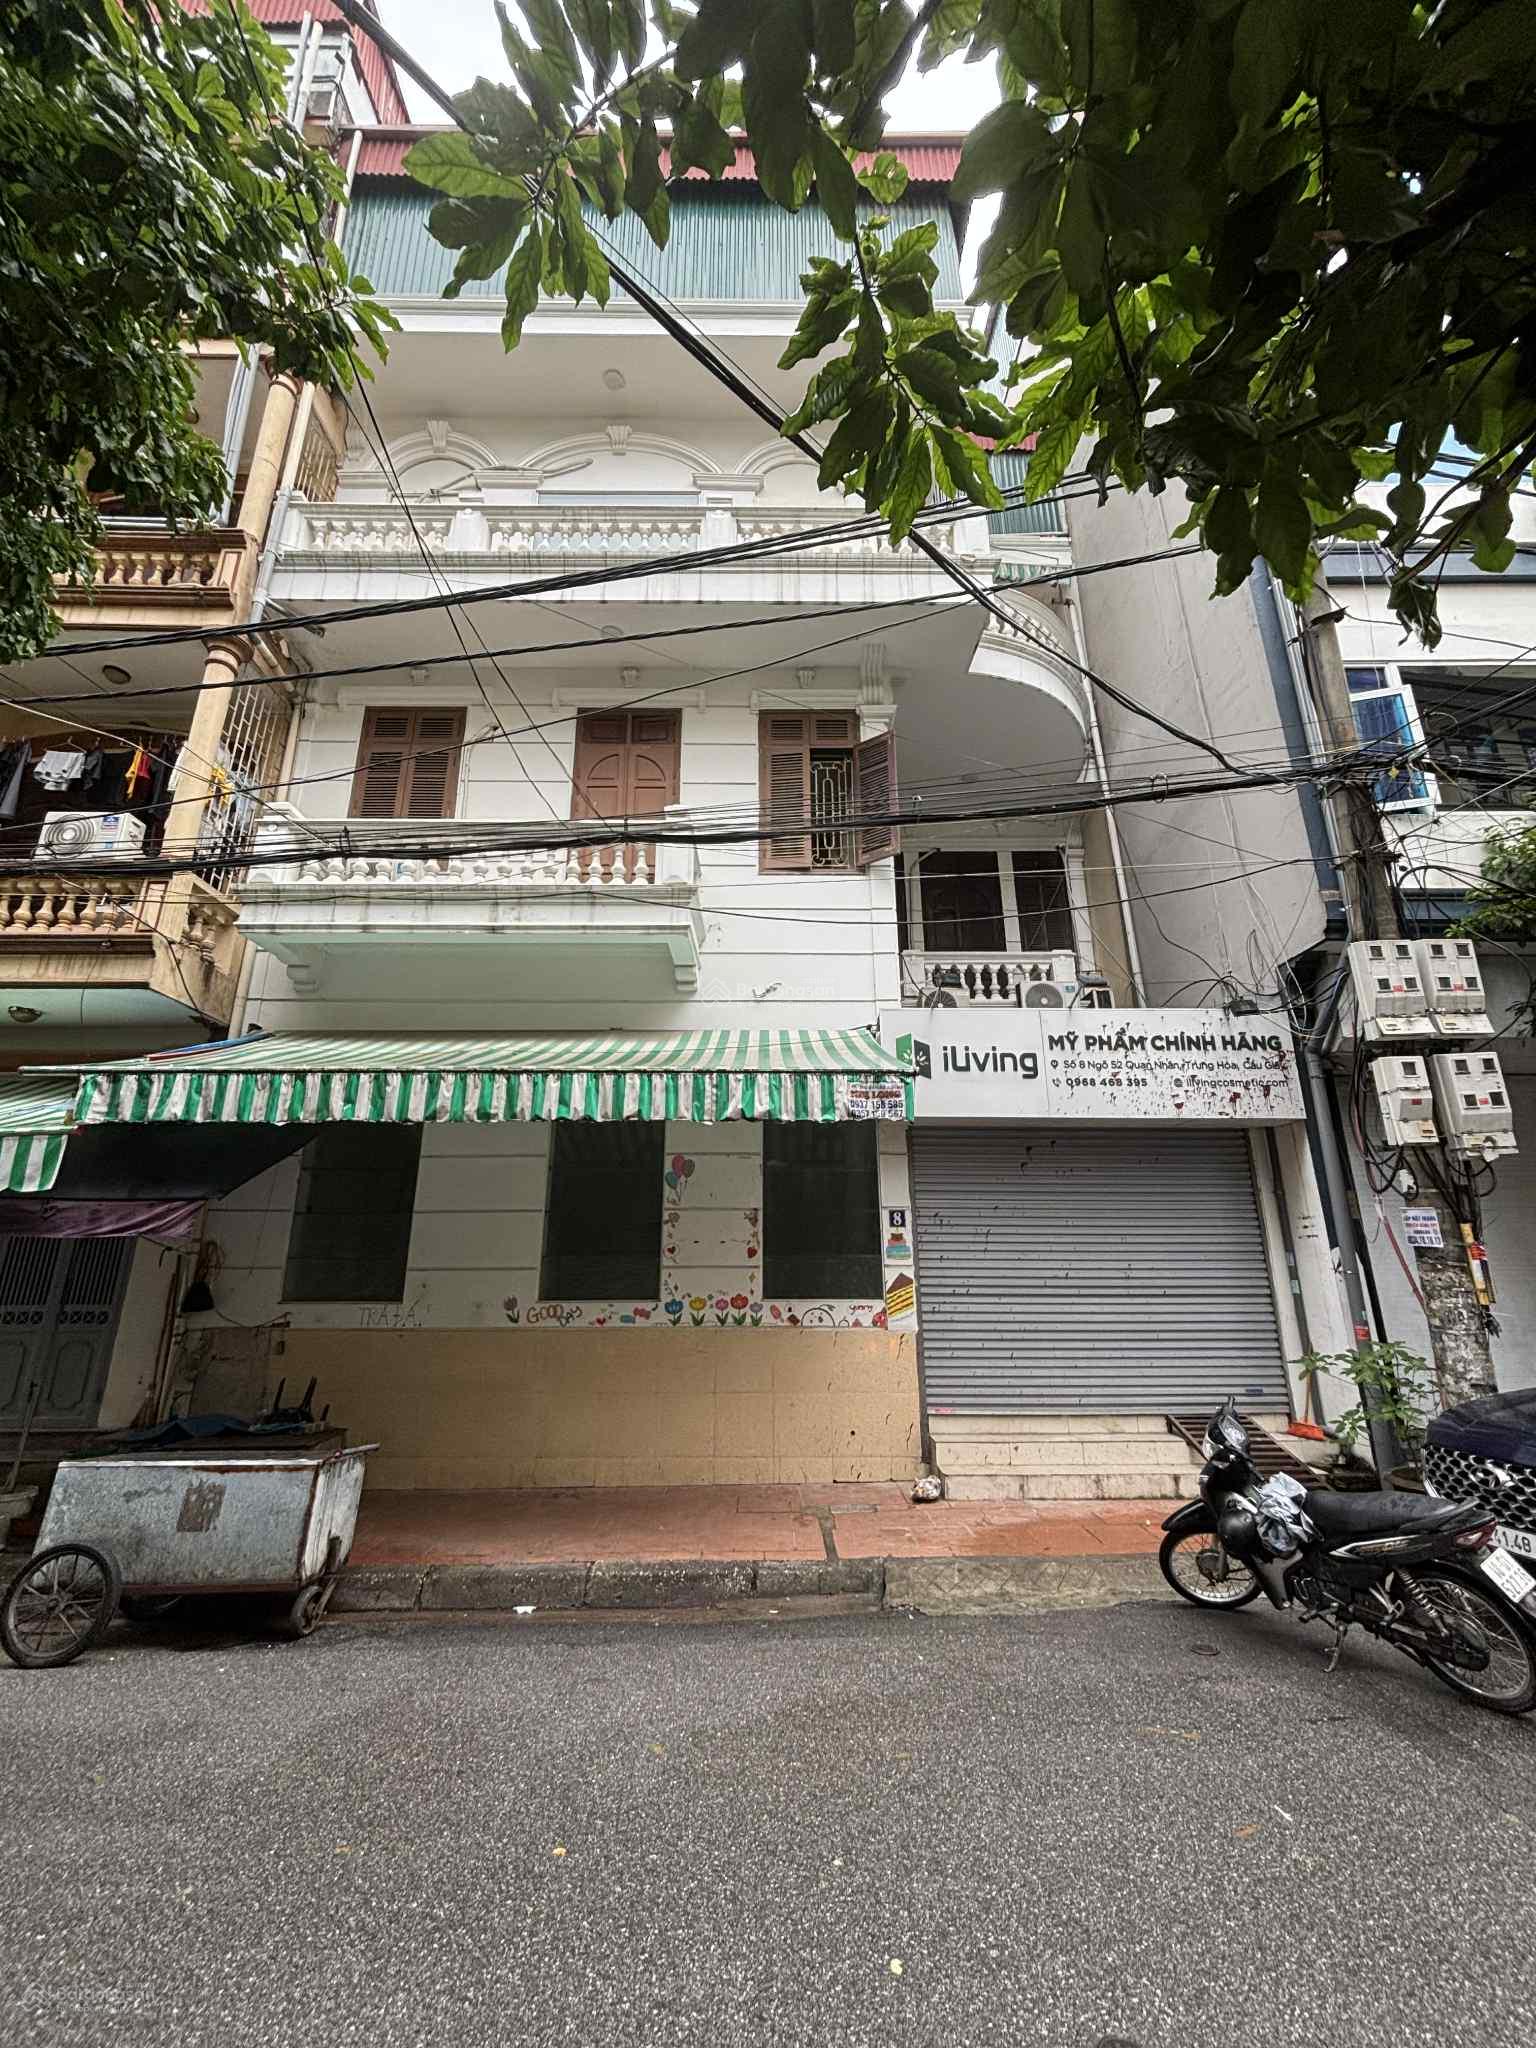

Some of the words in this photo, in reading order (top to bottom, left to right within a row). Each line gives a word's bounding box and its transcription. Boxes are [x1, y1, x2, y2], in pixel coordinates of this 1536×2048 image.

[1048, 1031, 1079, 1051] MỸ
[1084, 1027, 1147, 1051] PHẨM
[1150, 1031, 1217, 1051] CHÍNH
[1221, 1031, 1282, 1051] HÃNG
[1184, 1060, 1215, 1072] Trung
[893, 1211, 903, 1226] 8
